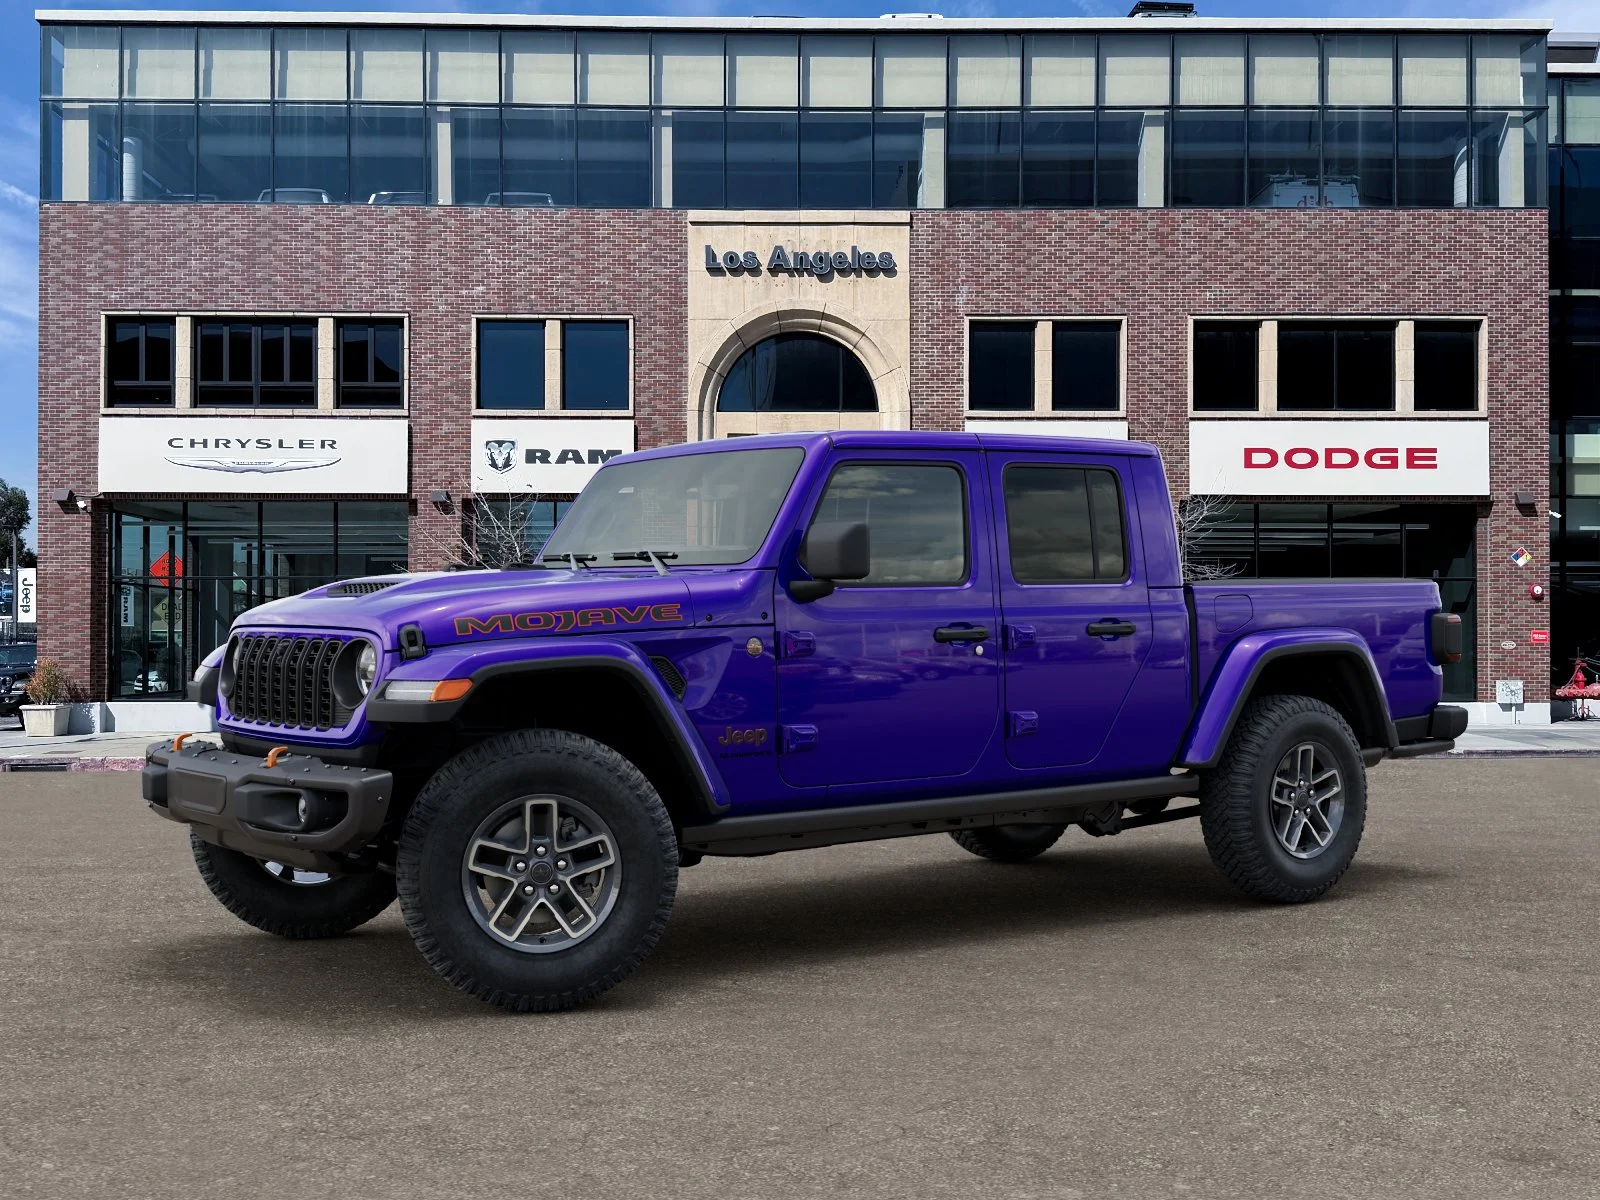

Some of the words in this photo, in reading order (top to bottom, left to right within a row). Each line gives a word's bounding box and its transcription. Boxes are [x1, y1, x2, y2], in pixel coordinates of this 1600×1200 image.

[704, 244, 759, 269] Los
[767, 244, 895, 275] Angeles
[167, 437, 338, 450] CHRYSLER
[525, 448, 622, 465] RAM
[1243, 447, 1438, 470] DODGE
[20, 577, 34, 613] Jeep
[165, 612, 181, 620] ED
[453, 603, 683, 635] MOJAVE
[718, 726, 767, 747] Jeep
